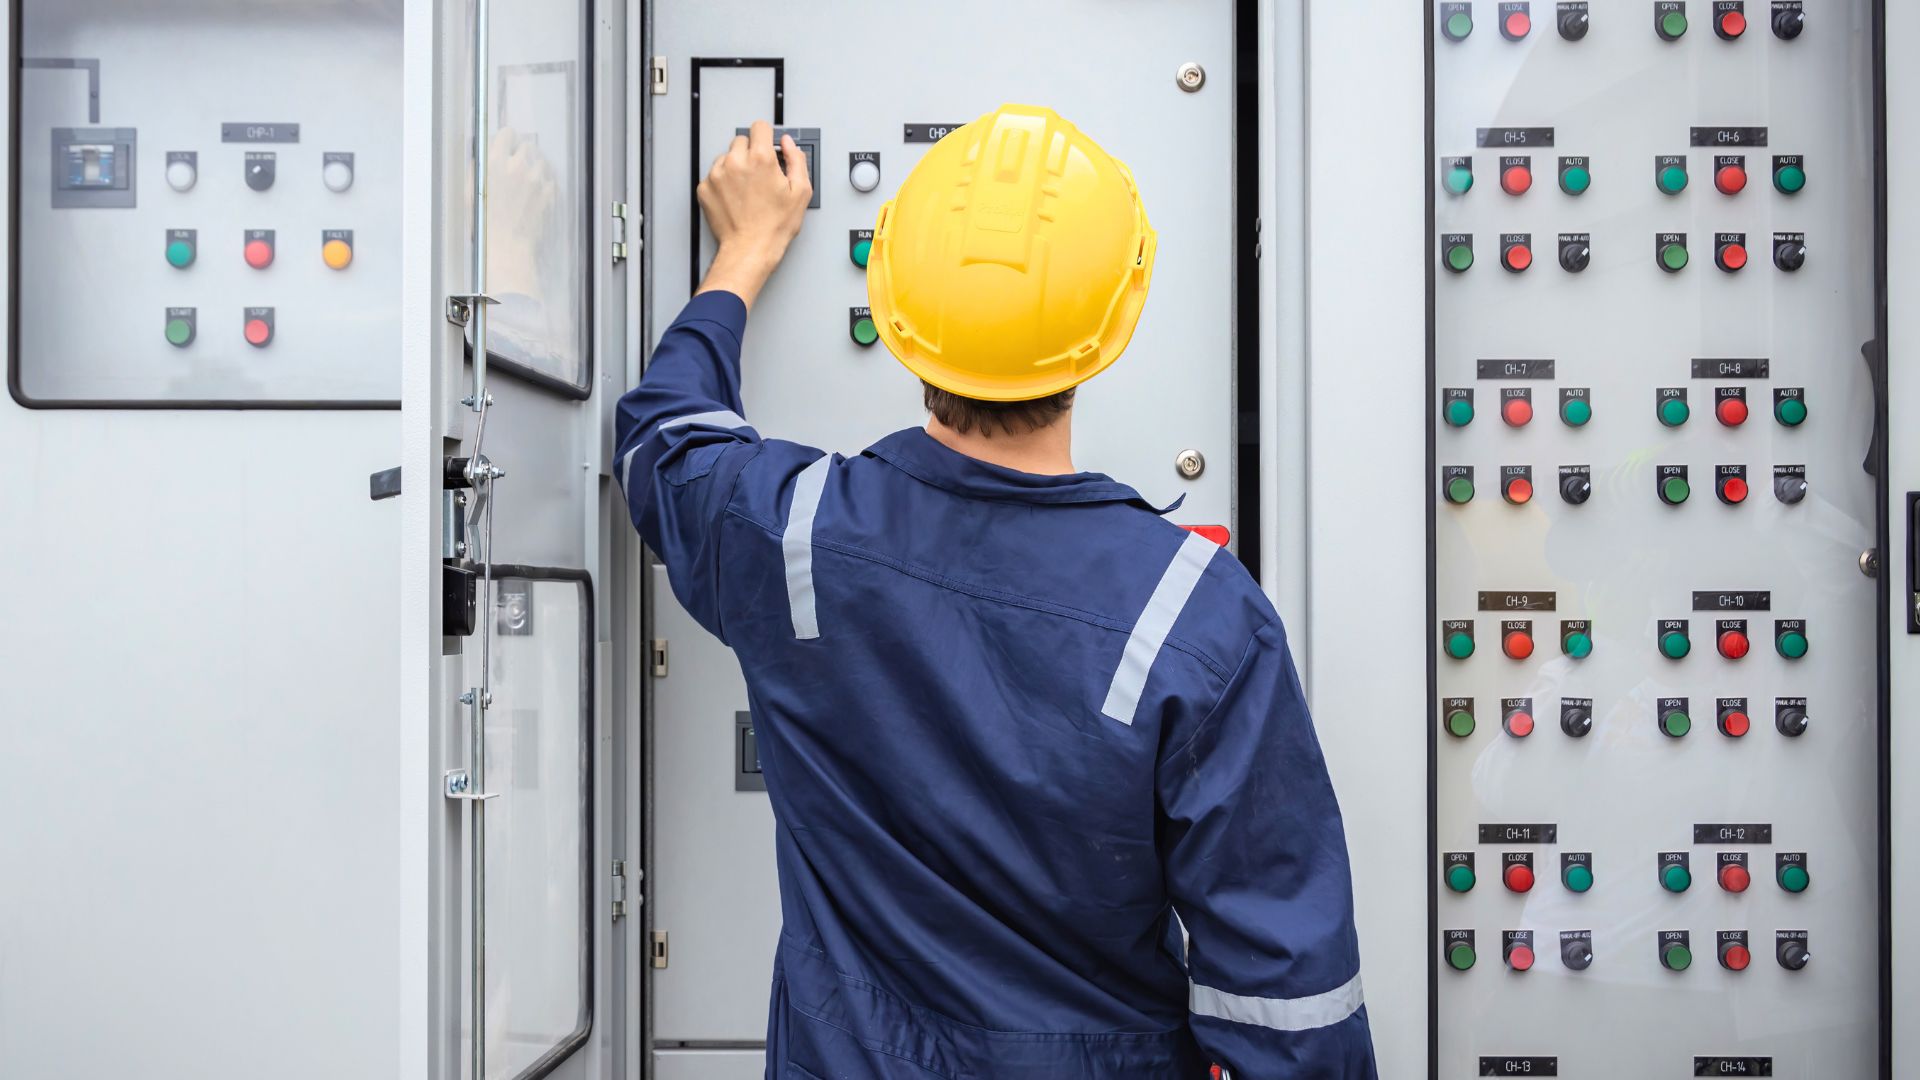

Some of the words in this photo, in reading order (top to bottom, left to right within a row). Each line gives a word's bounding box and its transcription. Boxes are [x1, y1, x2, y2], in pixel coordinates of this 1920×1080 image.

[247, 126, 274, 139] CHP-1
[1504, 131, 1526, 144] CH-5
[1717, 130, 1740, 144] CH-6
[854, 152, 874, 161] LOCAL
[858, 231, 872, 239] RUN
[854, 308, 871, 316] STAR
[1505, 363, 1527, 376] CH-7
[1719, 362, 1741, 375] CH-8
[1505, 595, 1528, 608] CH-9
[1719, 595, 1744, 607] CH-10
[1506, 827, 1530, 841] CH-11
[1719, 827, 1745, 841] CH-12
[1505, 1060, 1531, 1073] CH-13
[1720, 1060, 1746, 1073] CH-14
